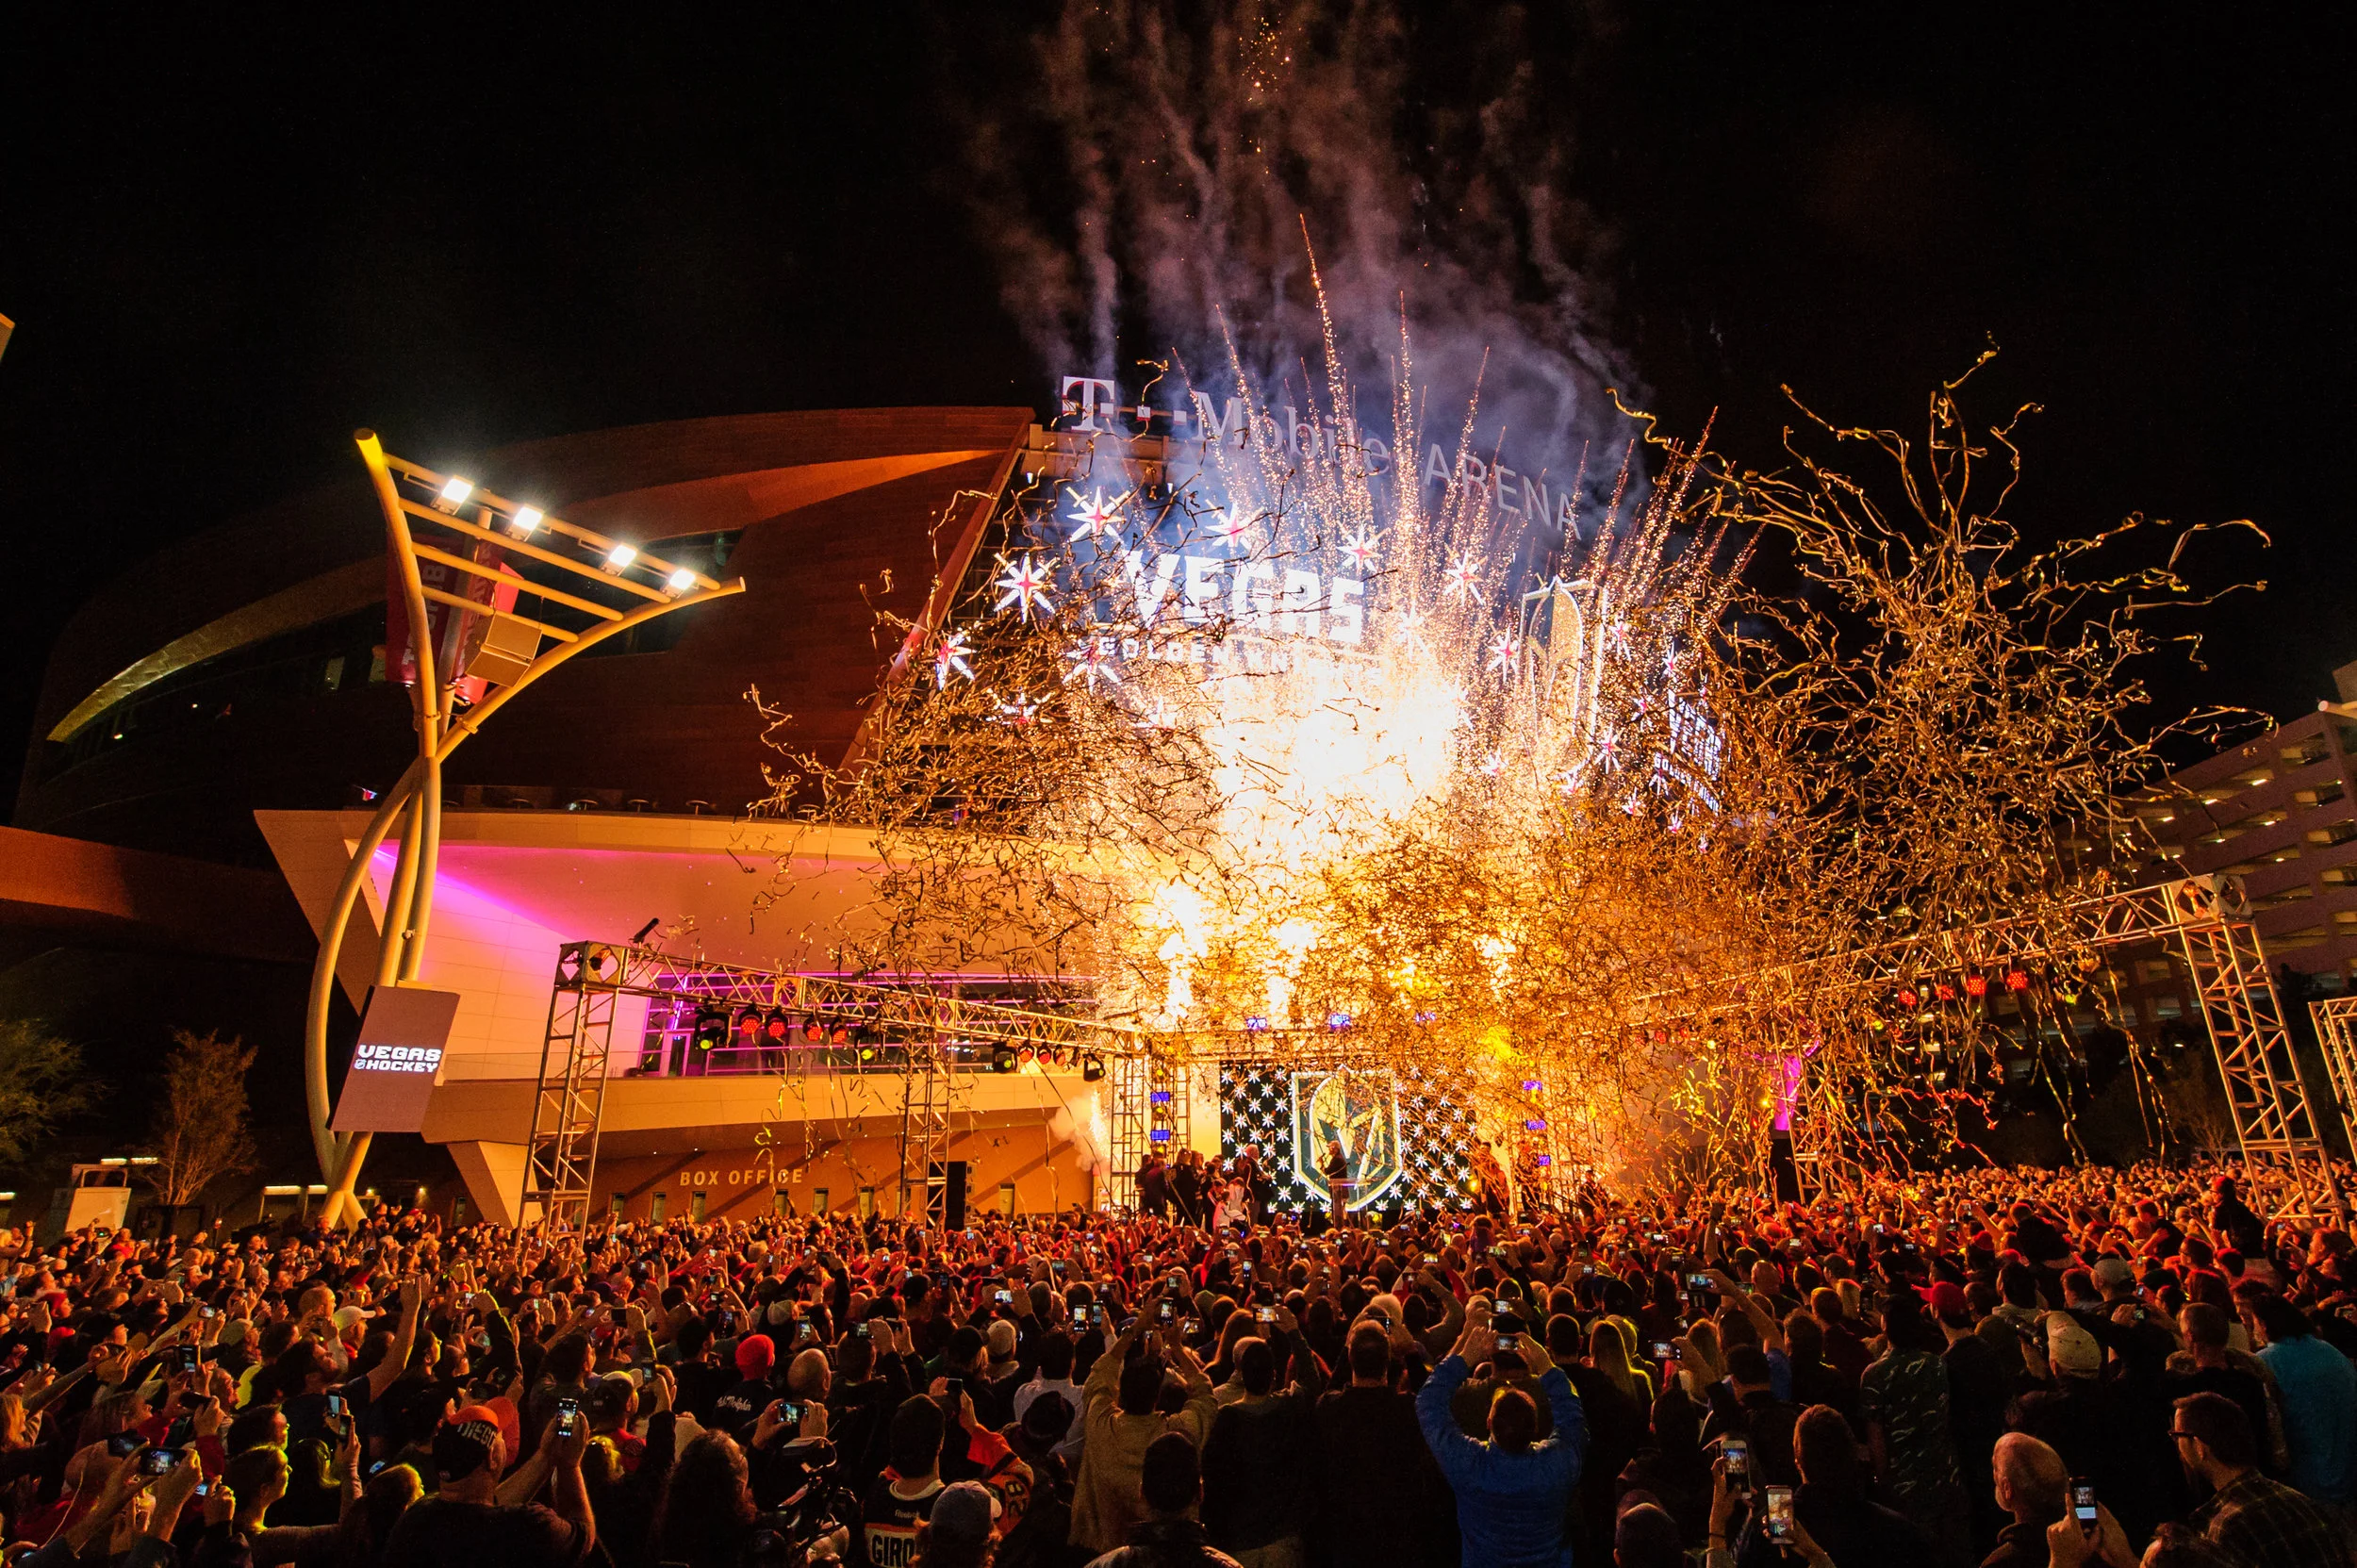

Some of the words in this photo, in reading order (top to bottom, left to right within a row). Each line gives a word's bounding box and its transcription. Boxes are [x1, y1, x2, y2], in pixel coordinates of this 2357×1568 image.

[1424, 443, 1582, 540] ARENA
[1121, 549, 1364, 644] VEGAS
[357, 1045, 442, 1062] VEGAS
[366, 1060, 438, 1073] HOCKEY
[680, 1171, 719, 1186] BOX
[728, 1169, 803, 1185] OFFICE
